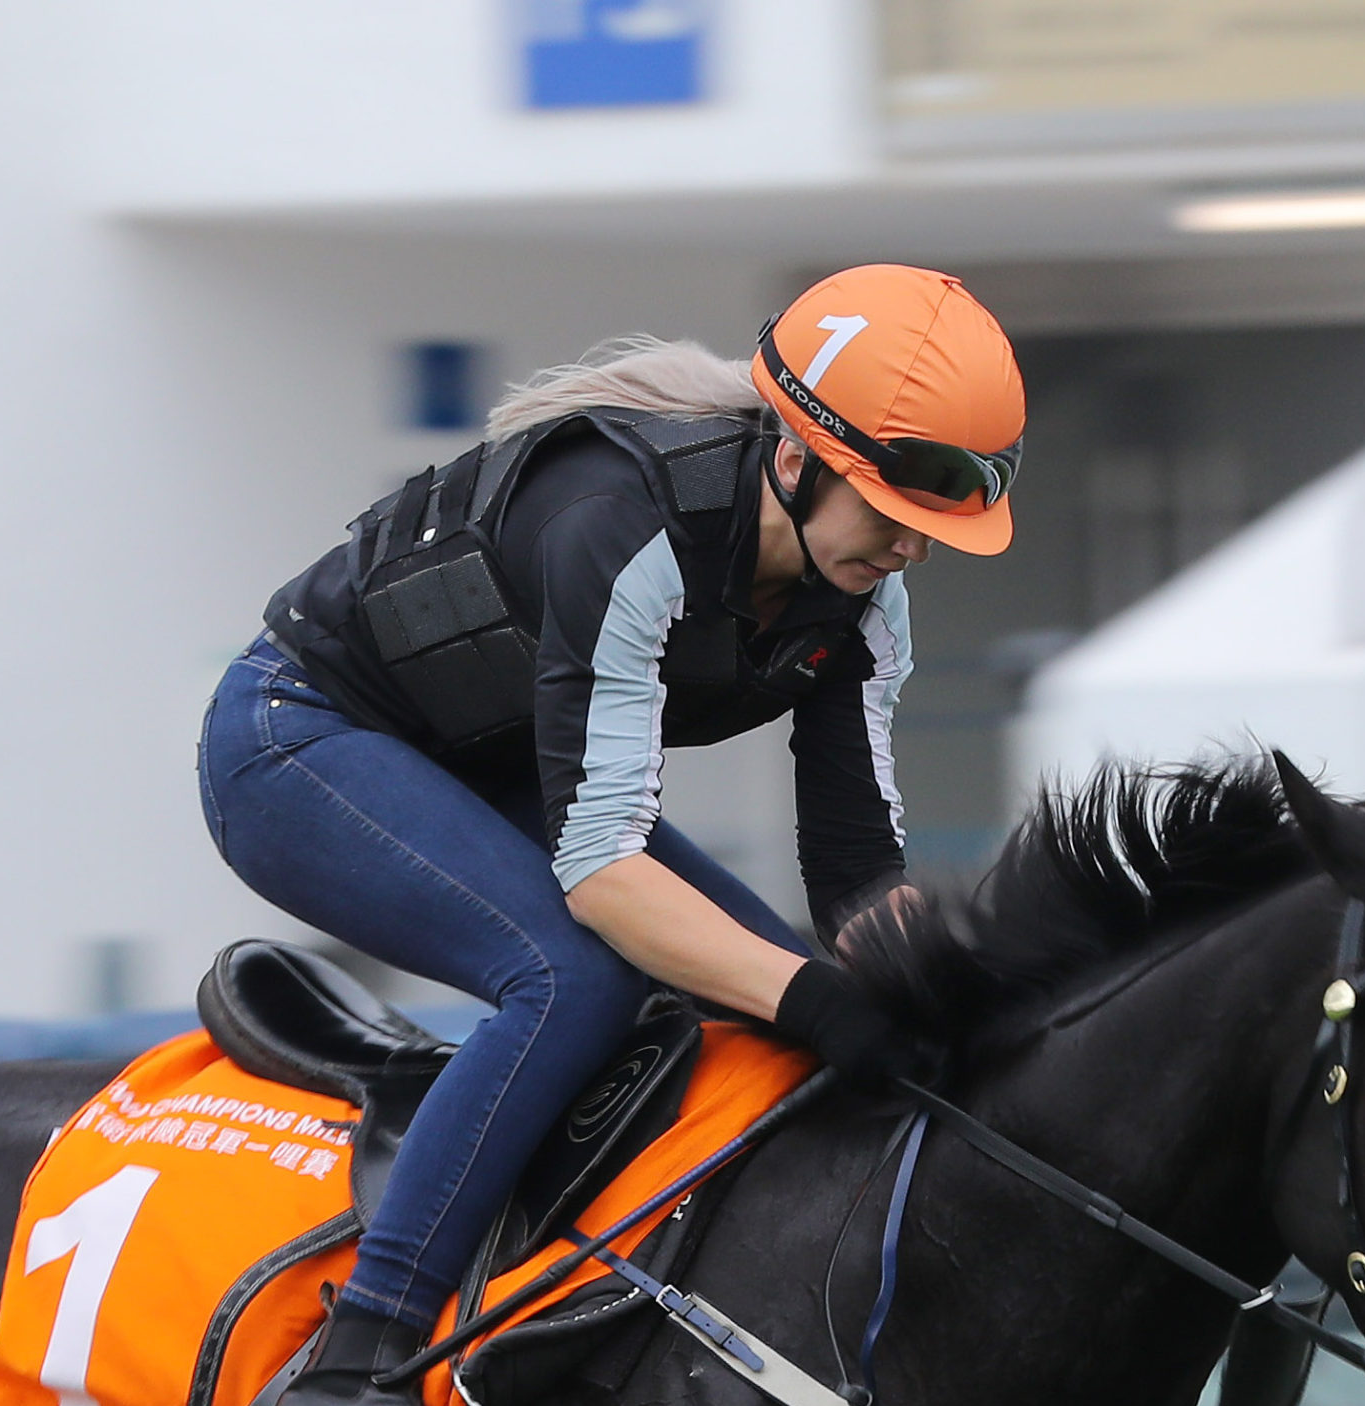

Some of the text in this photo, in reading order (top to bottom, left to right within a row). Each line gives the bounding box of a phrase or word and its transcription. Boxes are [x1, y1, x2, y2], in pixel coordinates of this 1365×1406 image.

[801, 314, 869, 391] 1
[776, 367, 846, 438] Kroop's
[149, 1093, 298, 1131] CHAMPIONS
